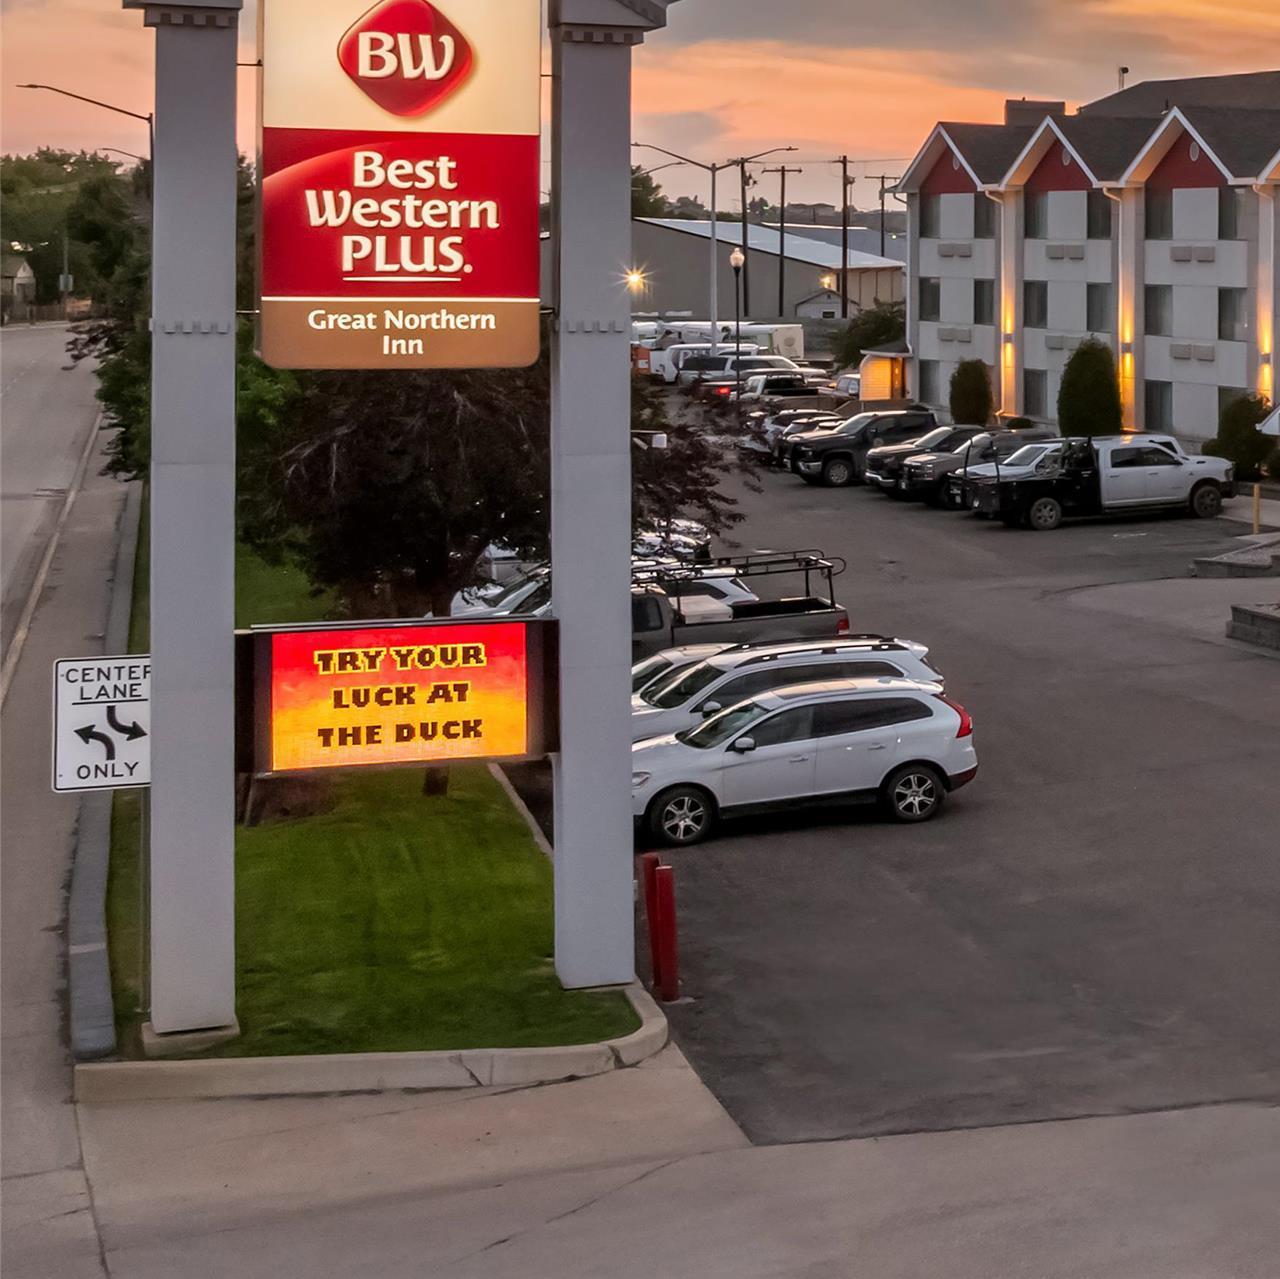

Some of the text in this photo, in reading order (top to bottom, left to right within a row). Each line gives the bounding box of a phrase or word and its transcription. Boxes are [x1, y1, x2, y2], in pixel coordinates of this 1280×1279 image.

[358, 31, 455, 80] BW
[353, 150, 458, 190] Best
[304, 189, 500, 229] Western
[308, 308, 496, 330] Great Northern
[383, 335, 424, 355] Inn
[315, 644, 486, 674] TRY YOUR
[80, 683, 142, 700] LANE
[333, 683, 469, 709] LUCK AT
[317, 719, 483, 747] THE DUCK
[77, 761, 139, 780] ONLY
